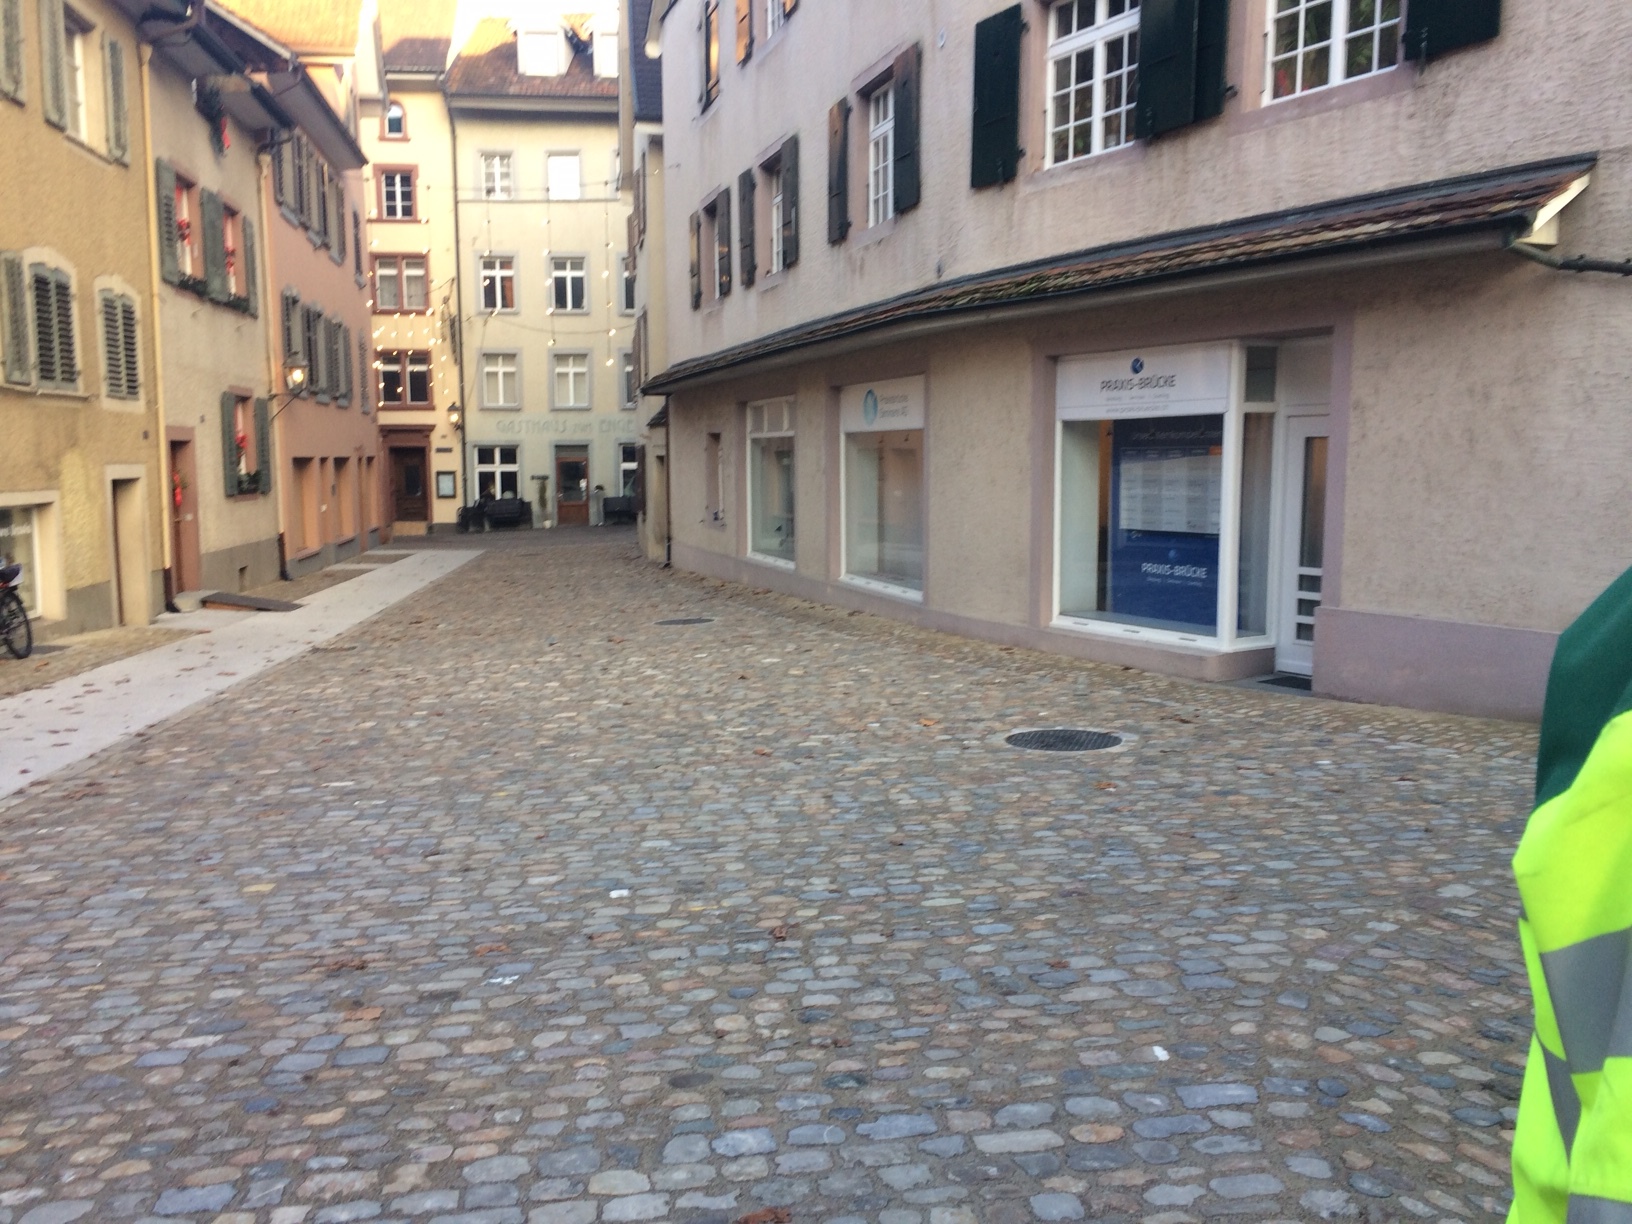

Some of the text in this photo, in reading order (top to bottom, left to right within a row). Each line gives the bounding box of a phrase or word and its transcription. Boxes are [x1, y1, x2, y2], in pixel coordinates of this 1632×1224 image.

[1100, 374, 1177, 391] PRAXIS-BRÜCKE
[496, 419, 568, 434] GASTHAUS
[1141, 562, 1208, 579] PRAXIS-BRÜCKE
